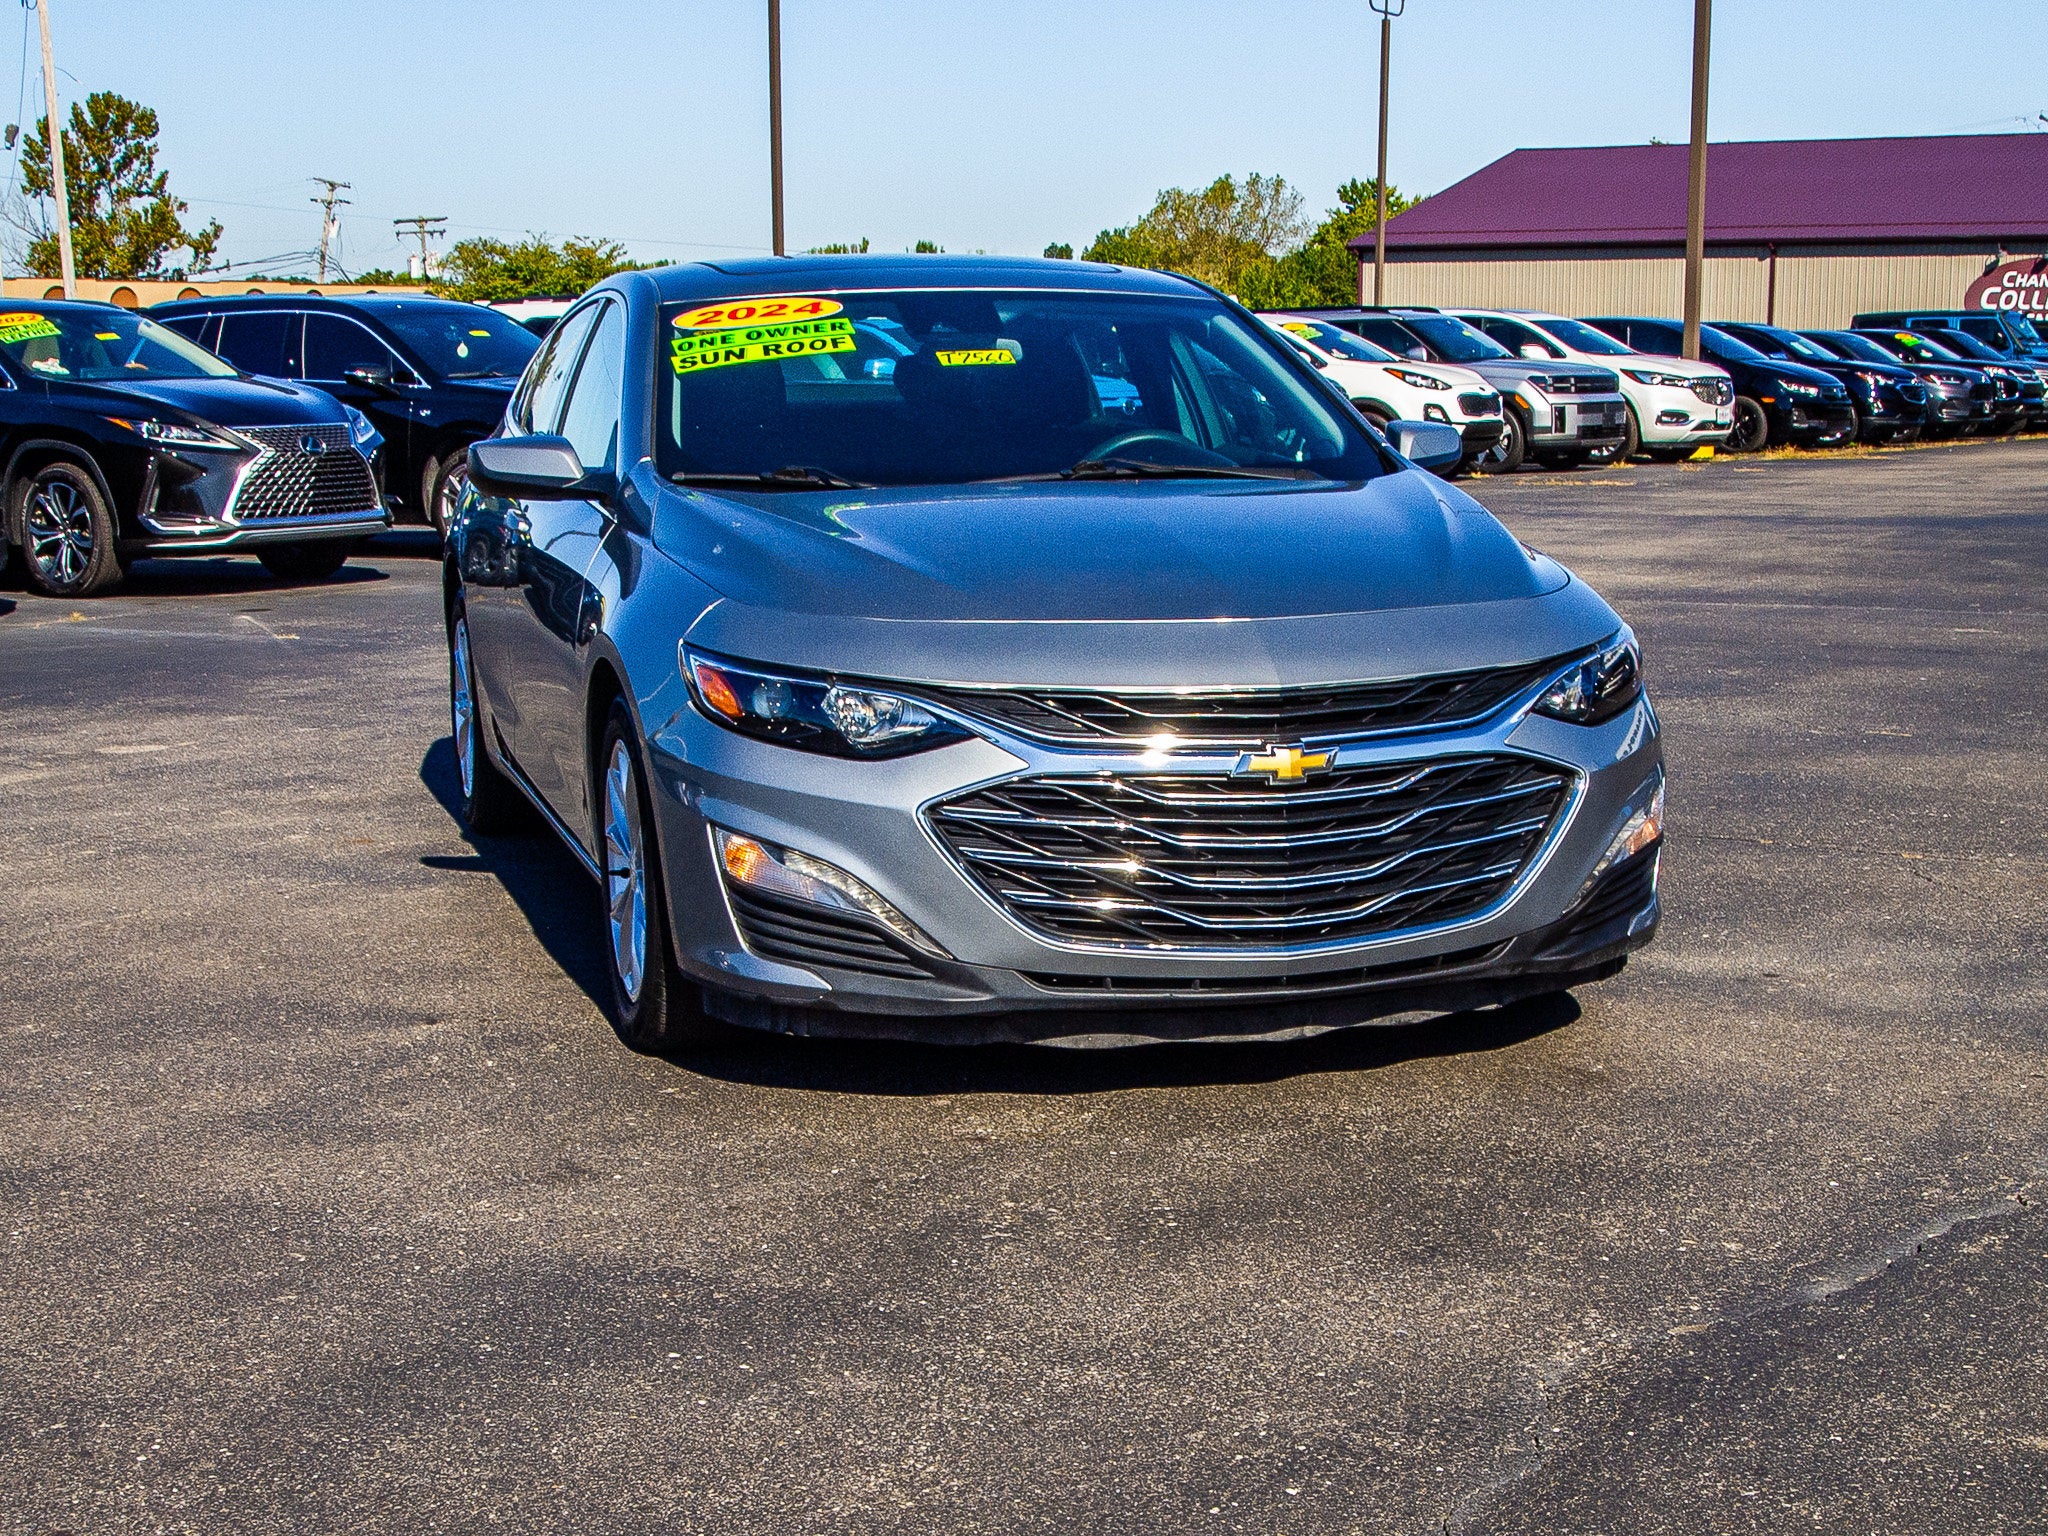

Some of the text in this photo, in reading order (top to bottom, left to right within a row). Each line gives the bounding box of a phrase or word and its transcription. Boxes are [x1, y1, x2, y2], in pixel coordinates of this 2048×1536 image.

[692, 301, 824, 326] 2024
[677, 321, 848, 352] ONE OWNER
[677, 336, 847, 370] SUN ROOF
